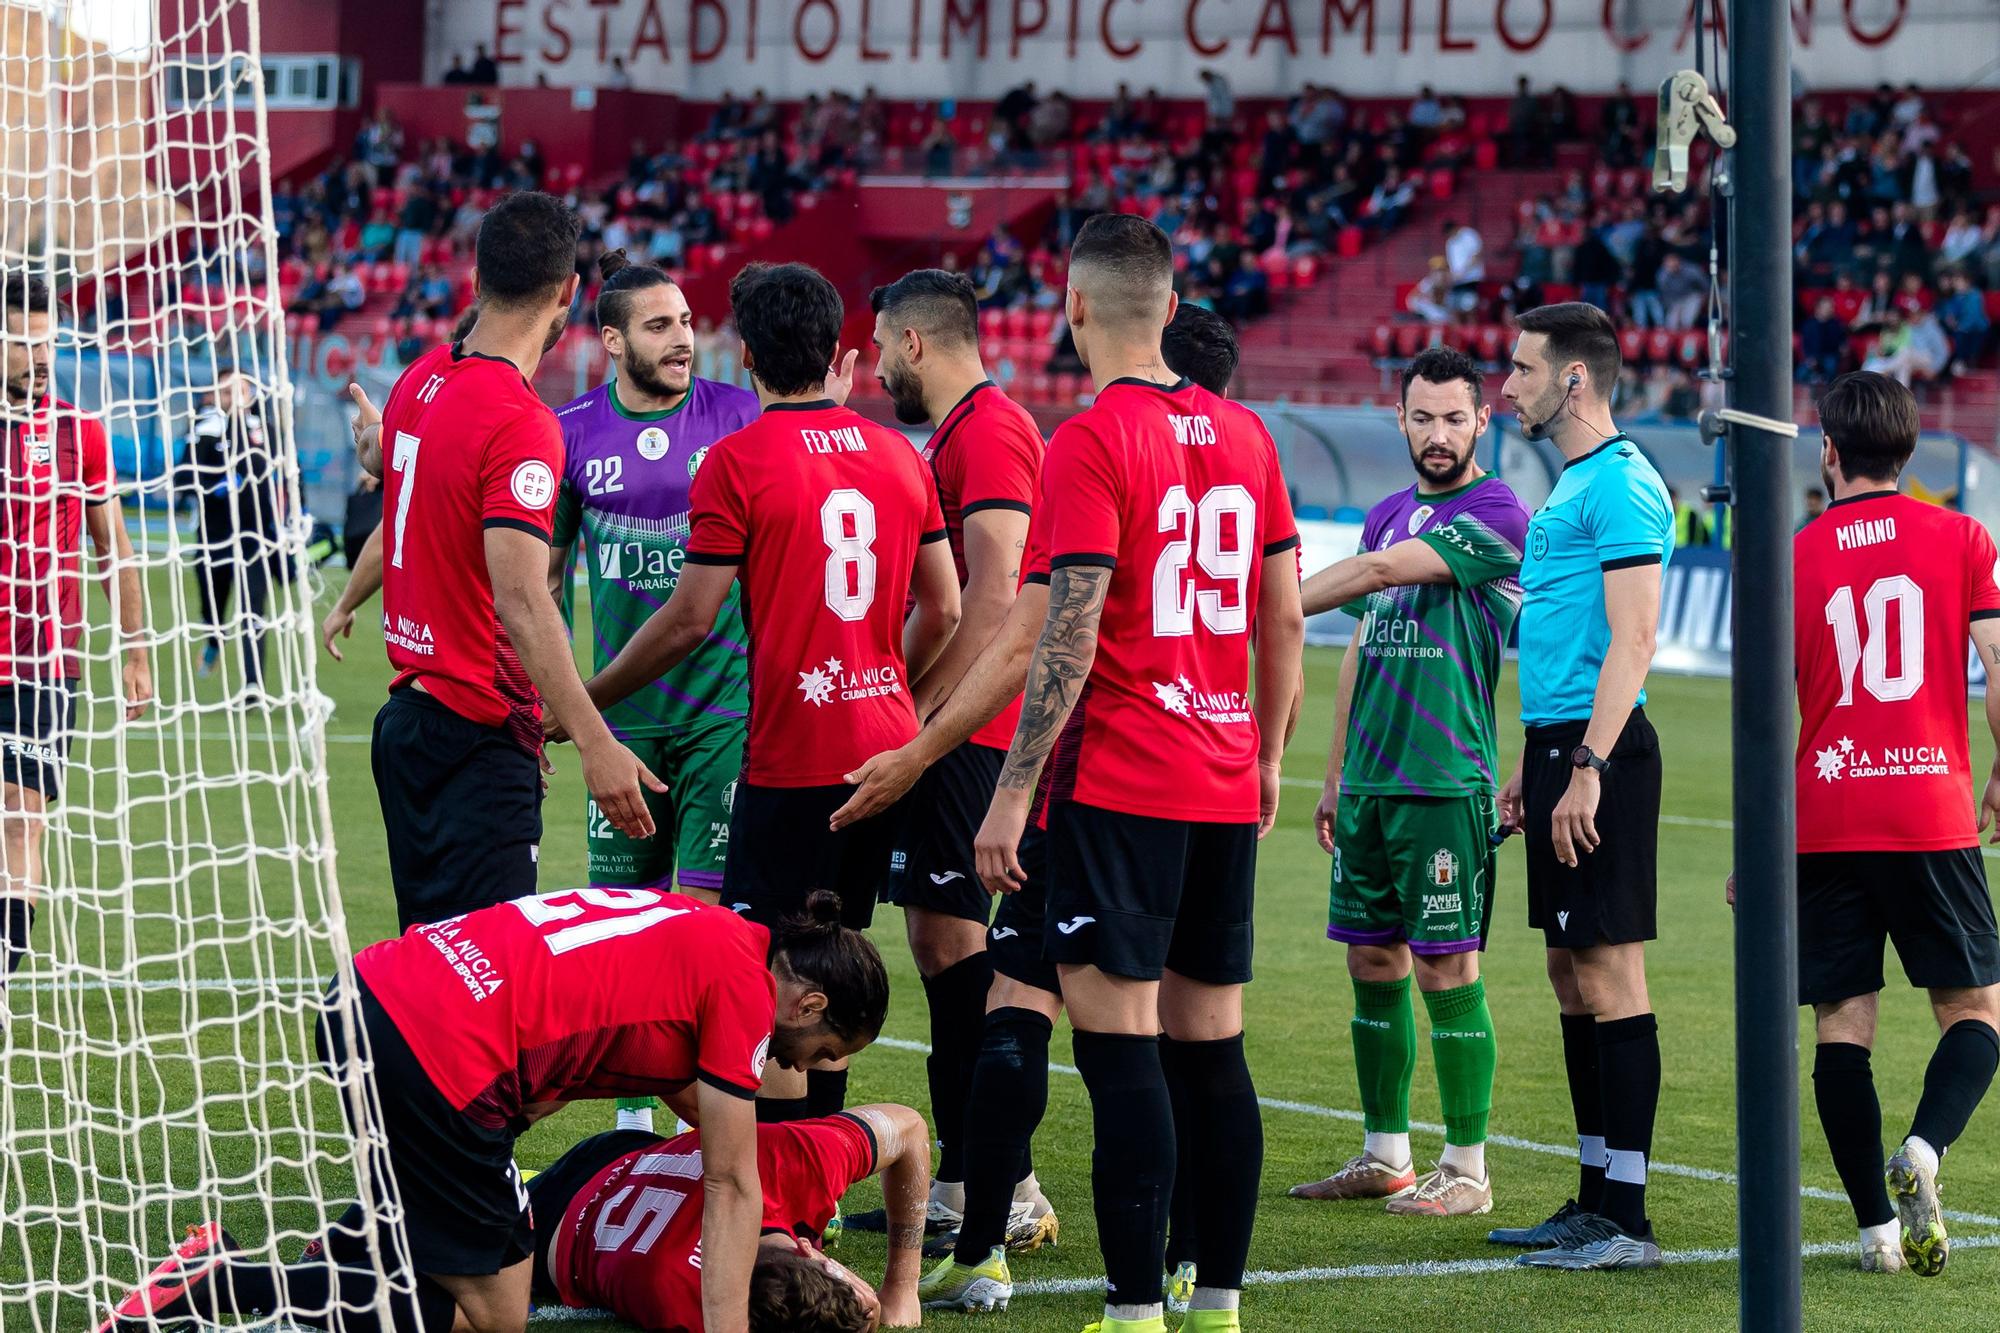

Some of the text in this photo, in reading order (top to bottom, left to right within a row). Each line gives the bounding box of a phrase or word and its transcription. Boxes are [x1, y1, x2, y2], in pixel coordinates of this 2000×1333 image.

[494, 0, 757, 64] ESTADI
[793, 0, 1142, 62] OLIMPIC
[1184, 0, 1554, 57] CAMILO
[801, 426, 868, 454] FER PINA
[586, 456, 624, 496] 22
[391, 430, 421, 569] 7
[1835, 517, 1896, 551] MIÑANO
[625, 539, 686, 579] Jaé
[820, 488, 877, 622] 8
[1153, 484, 1256, 637] 29
[1824, 574, 1924, 708] 10
[840, 671, 859, 689] LA
[1207, 690, 1249, 712] NUCí
[1849, 764, 1950, 778] CIUDAD DEL DEPORTE
[1850, 750, 1872, 767] LA
[1333, 846, 1342, 883] 3
[438, 922, 462, 941] LA
[506, 888, 693, 956] 21
[593, 1149, 704, 1255] 15
